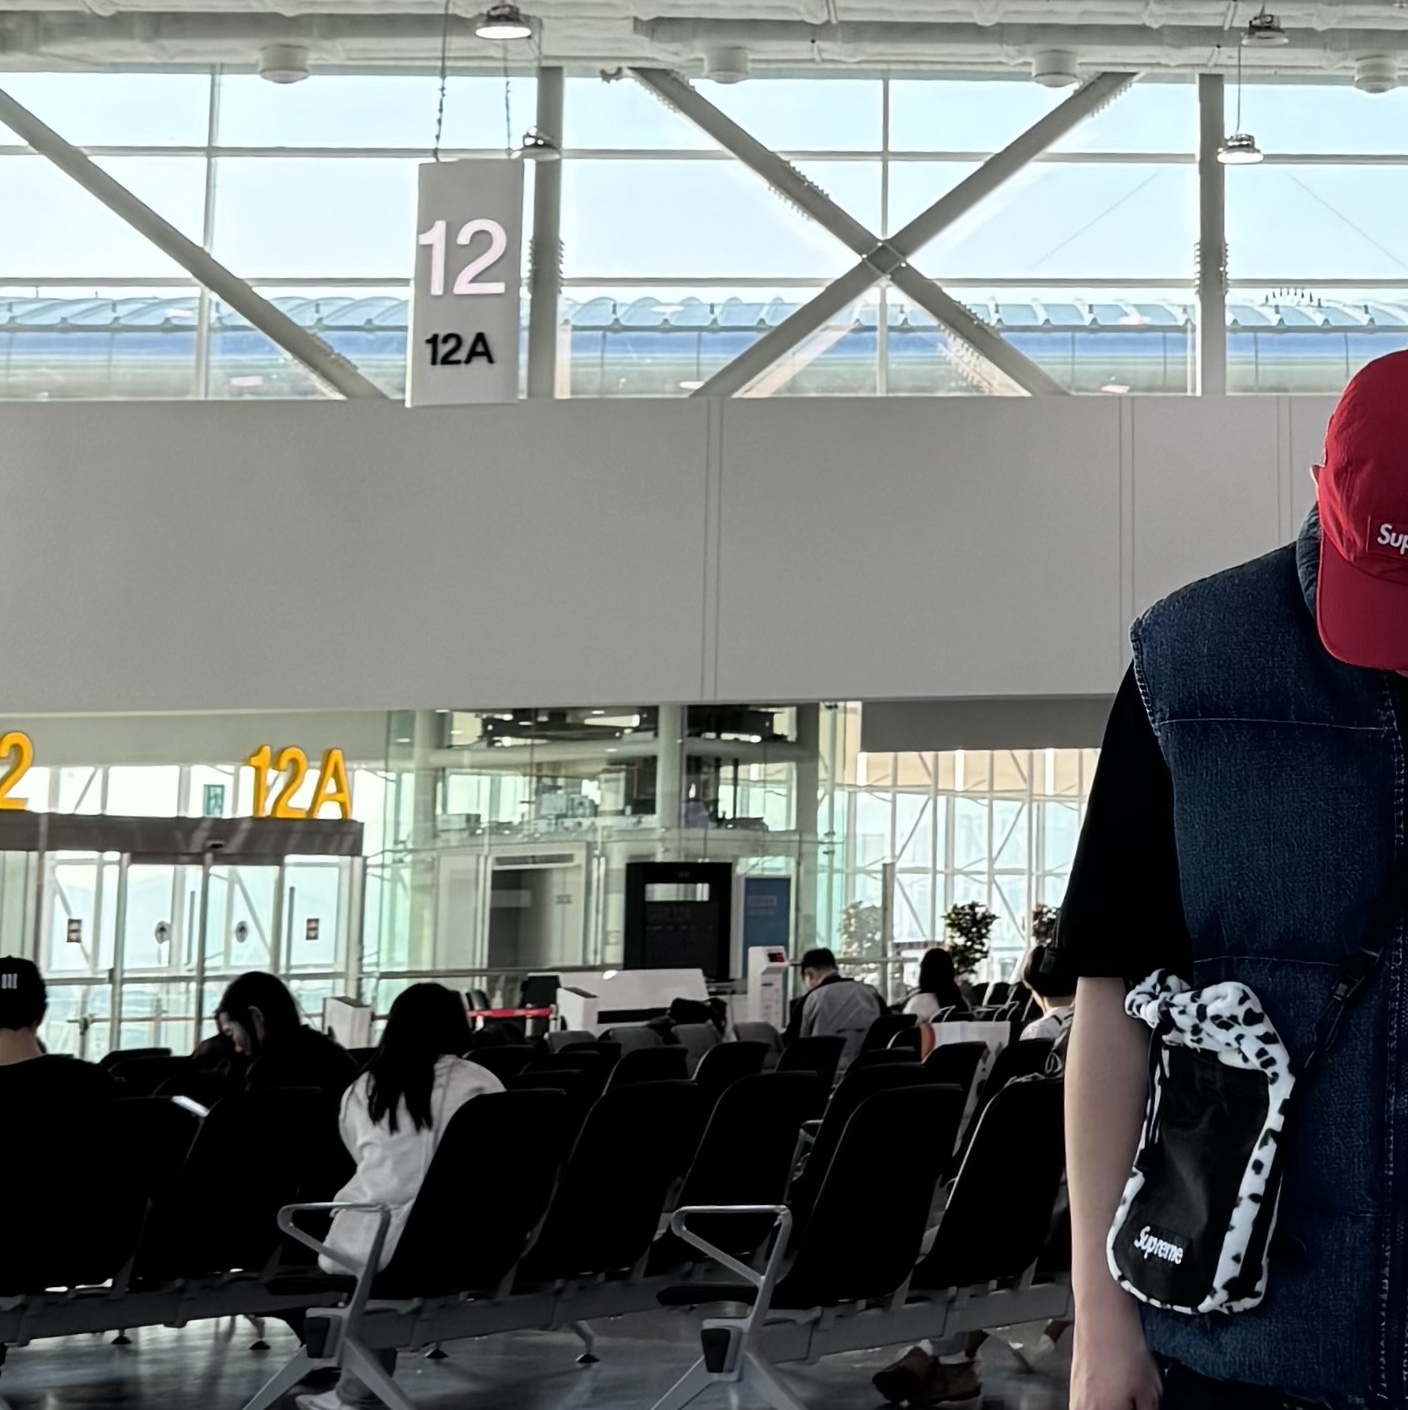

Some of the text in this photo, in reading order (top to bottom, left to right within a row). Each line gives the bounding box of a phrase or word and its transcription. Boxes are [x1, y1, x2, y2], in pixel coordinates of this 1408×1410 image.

[418, 218, 507, 296] 12
[425, 331, 495, 366] 12A
[245, 745, 352, 820] 12A
[1133, 1225, 1184, 1265] Supreme
